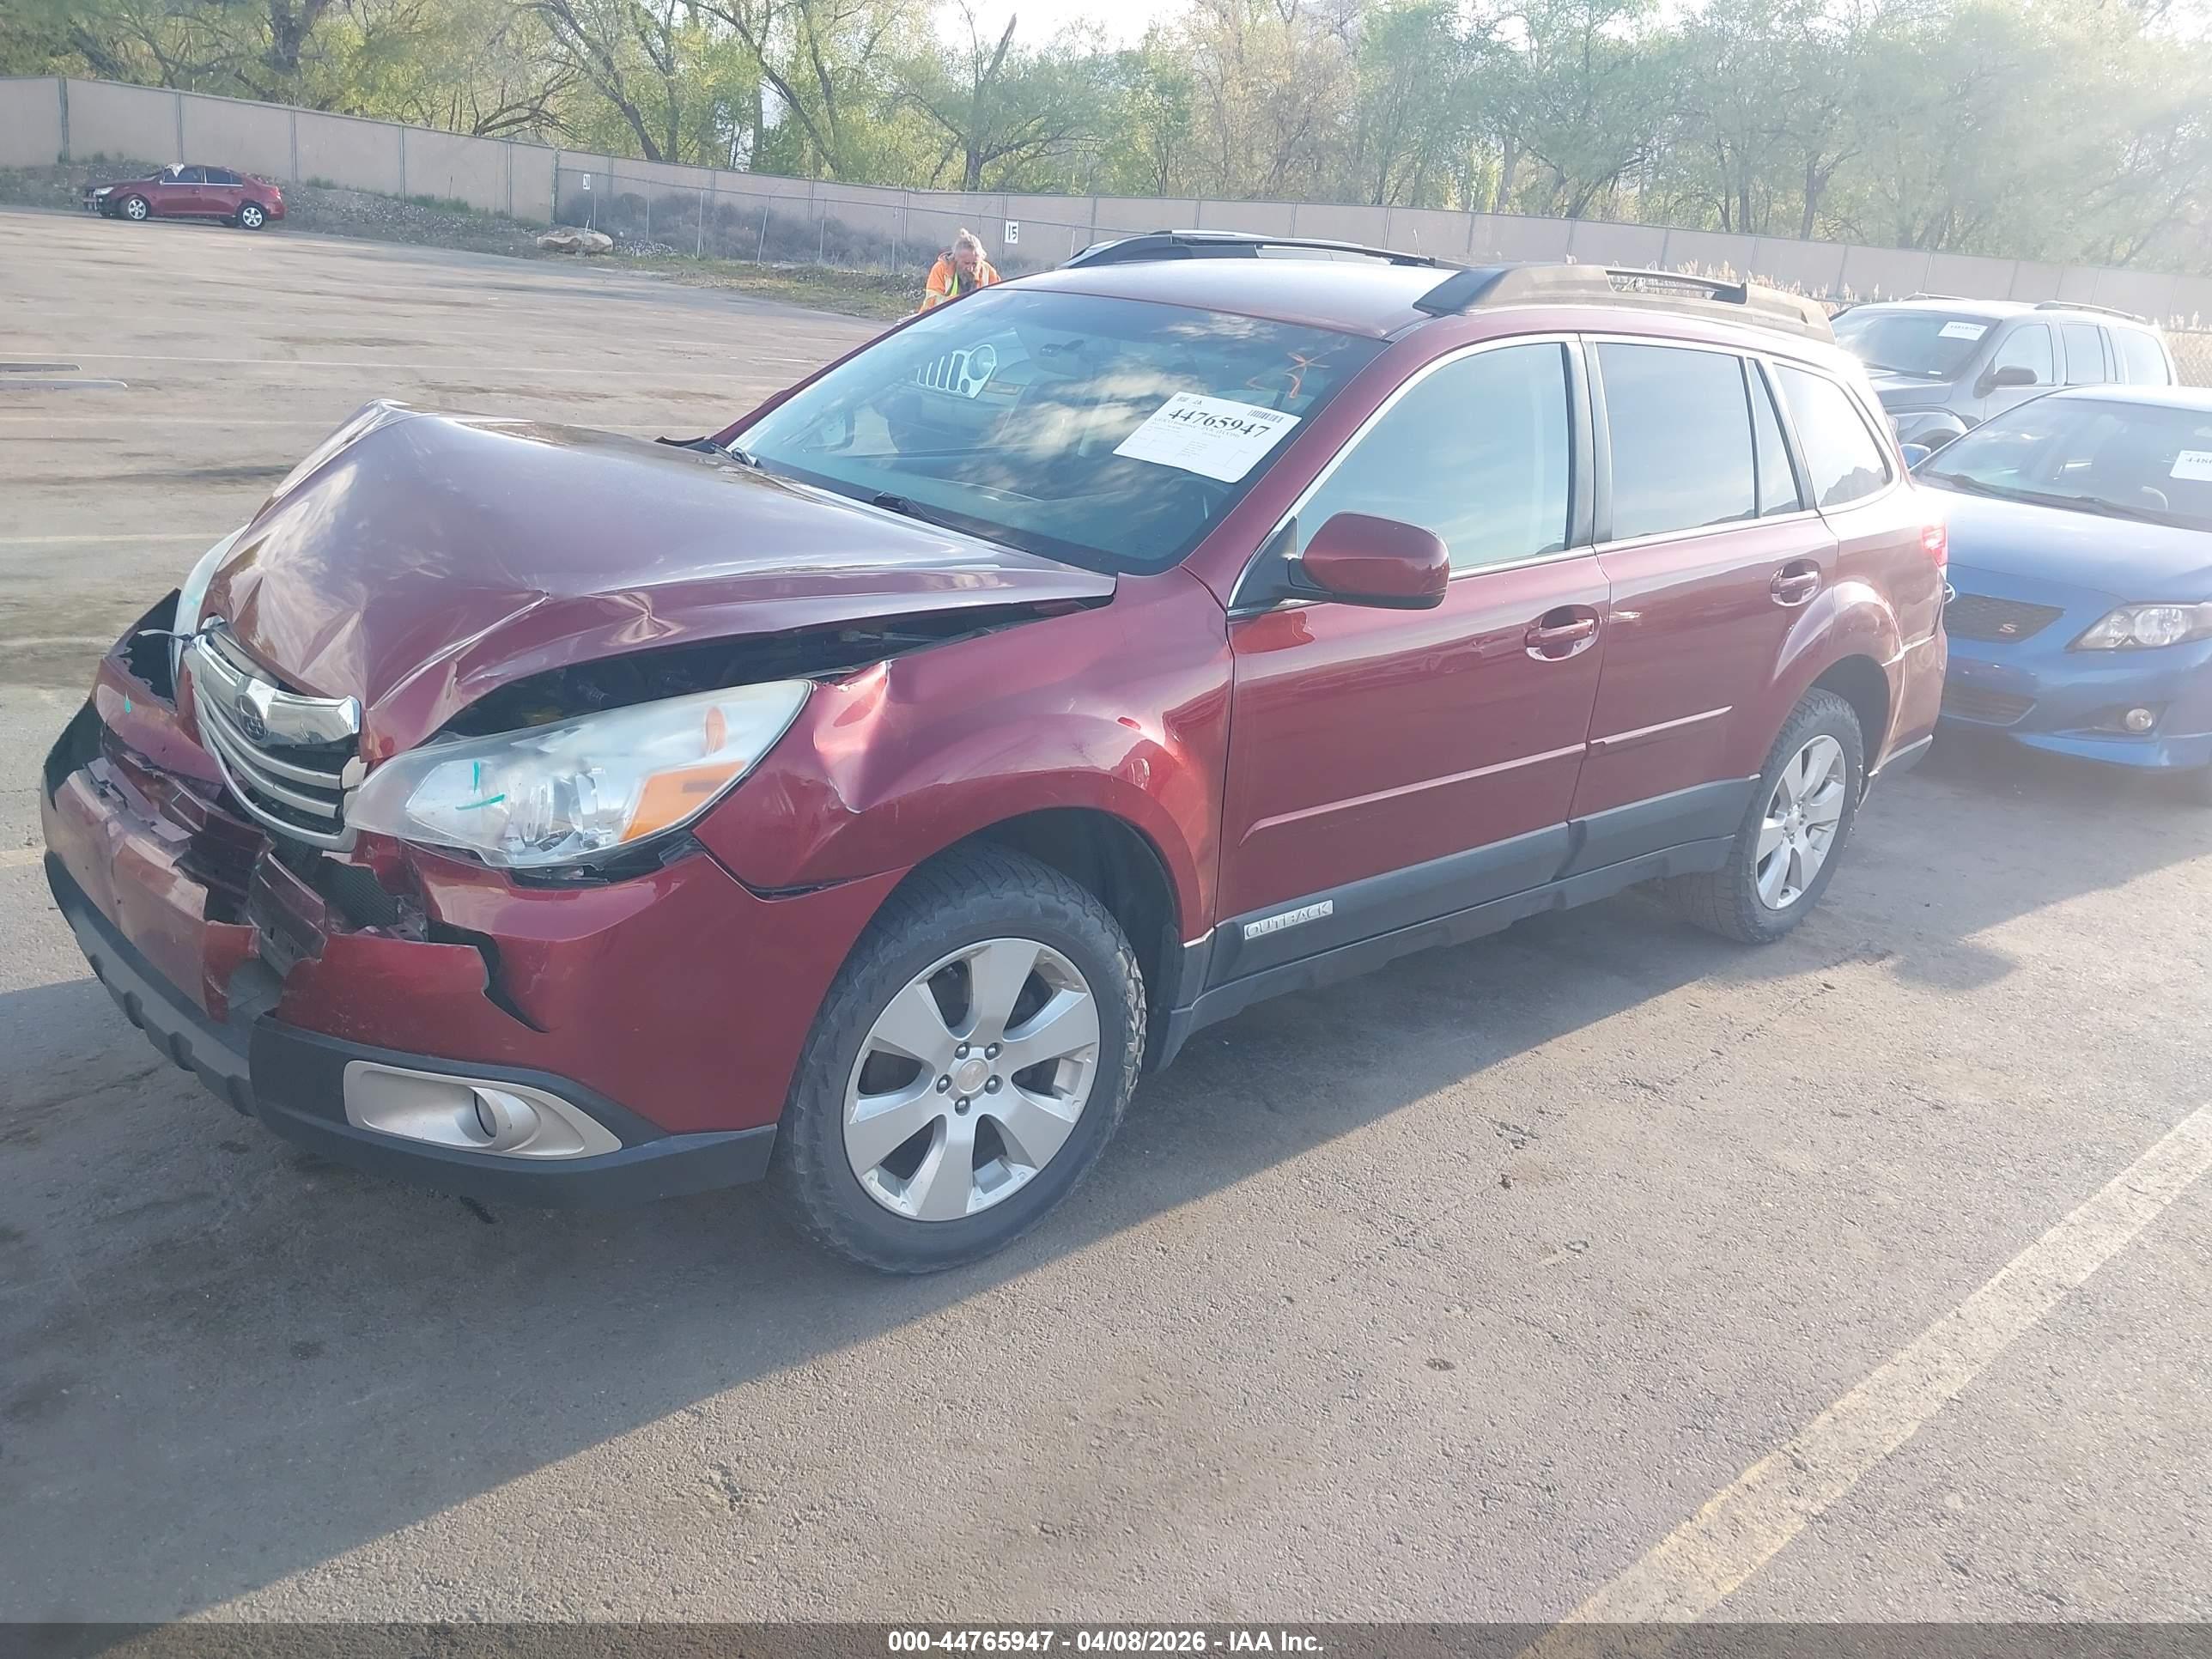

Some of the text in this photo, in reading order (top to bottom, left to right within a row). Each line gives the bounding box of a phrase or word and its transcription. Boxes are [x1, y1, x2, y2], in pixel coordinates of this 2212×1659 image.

[1008, 223, 1018, 240] 15
[1169, 408, 1271, 438] 44765947
[1999, 623, 2018, 633] S
[1245, 902, 1331, 938] OUTBACK
